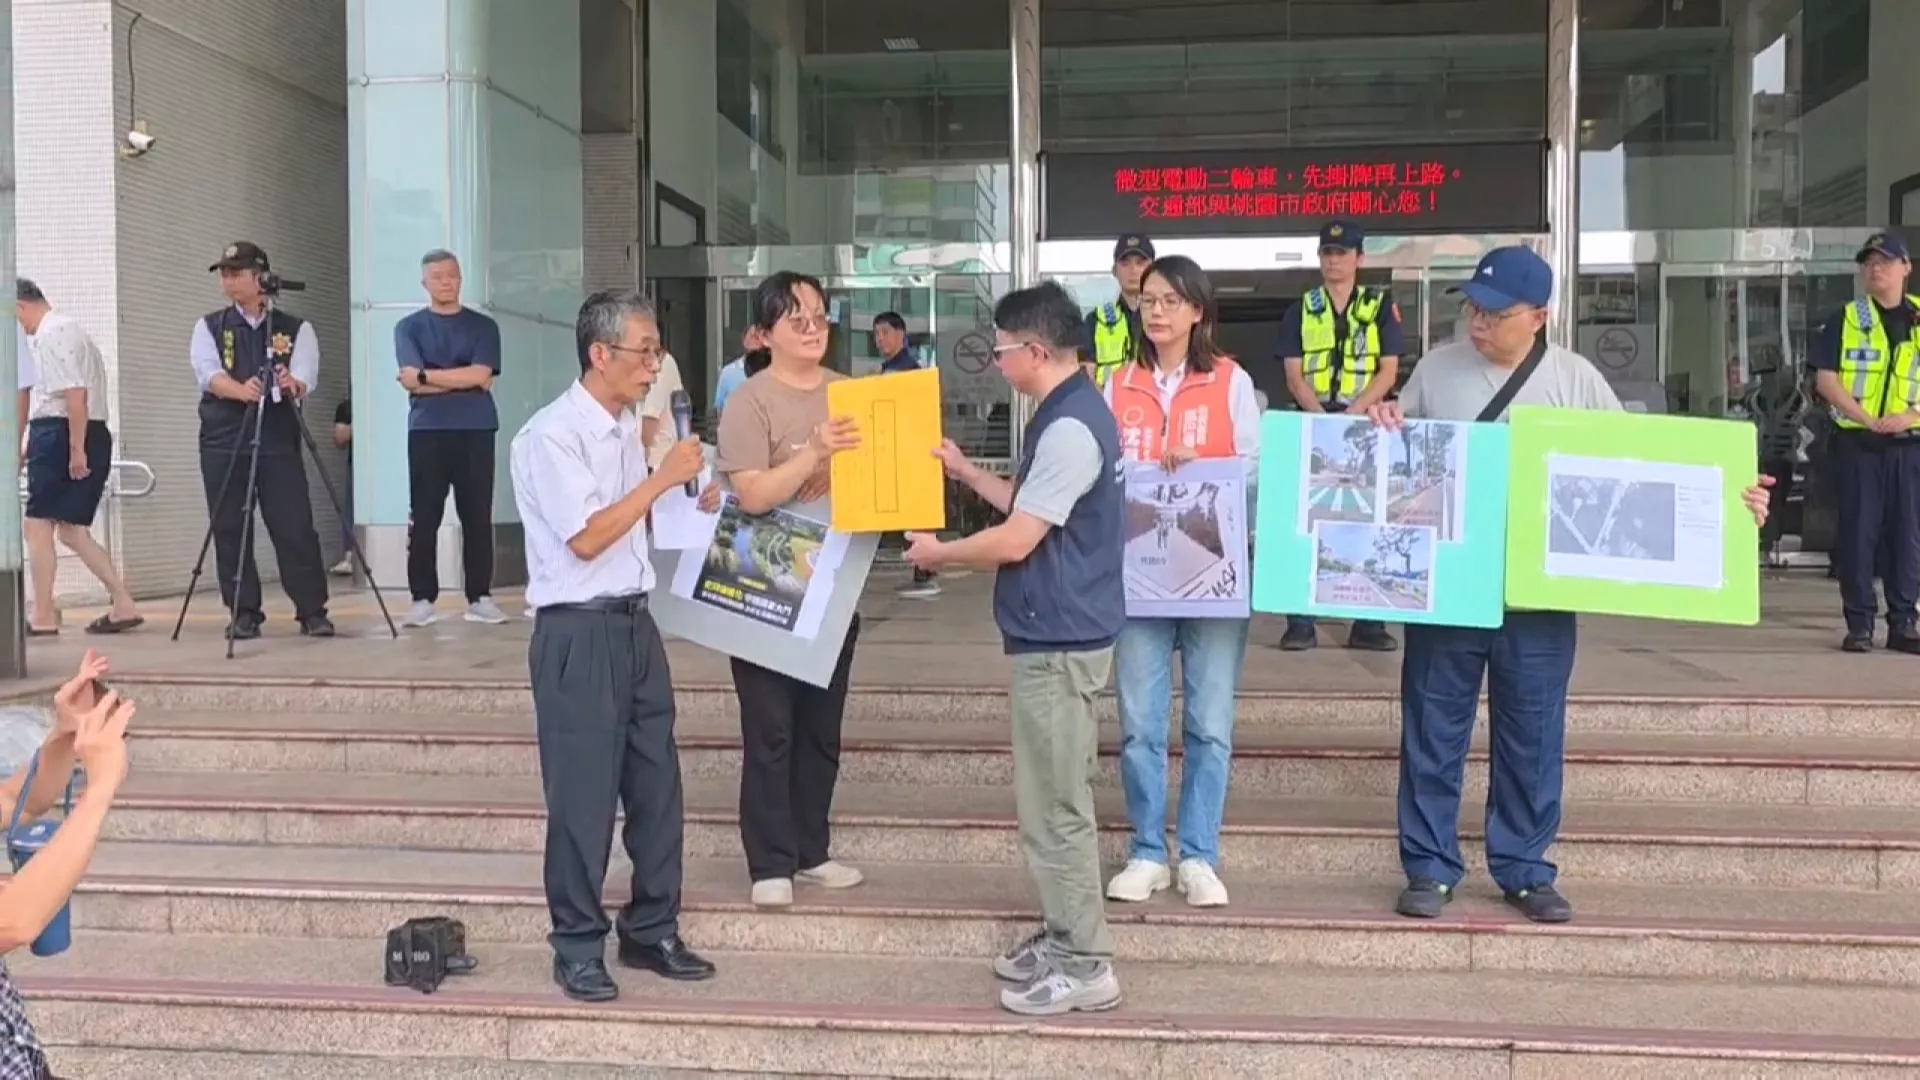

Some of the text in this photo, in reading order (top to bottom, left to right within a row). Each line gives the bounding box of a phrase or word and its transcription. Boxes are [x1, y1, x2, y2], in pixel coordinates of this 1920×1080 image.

[1138, 189, 1438, 218] 交通部與桃園市政府關心您！
